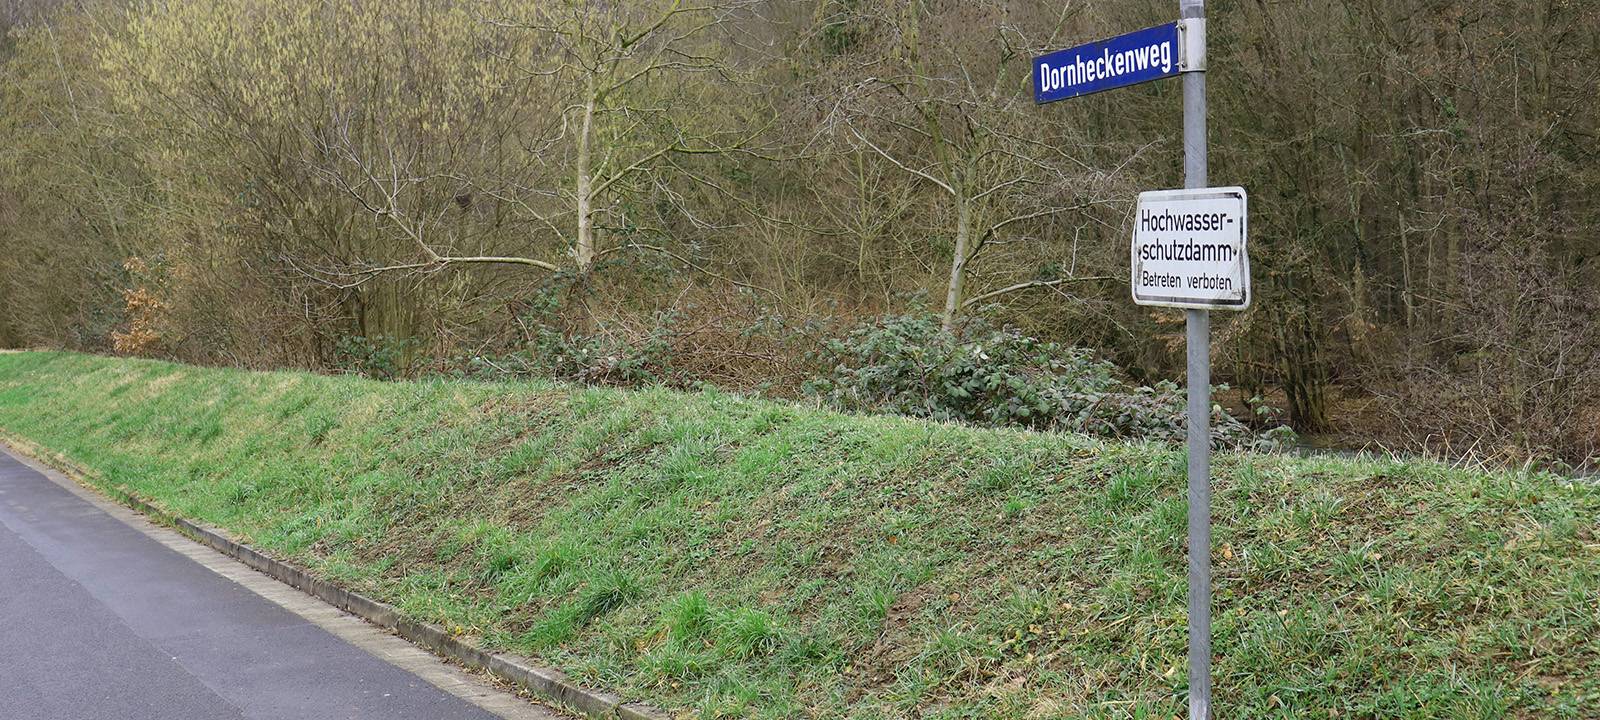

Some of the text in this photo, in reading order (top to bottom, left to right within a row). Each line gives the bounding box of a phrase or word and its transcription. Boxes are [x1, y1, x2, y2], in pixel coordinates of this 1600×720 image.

[1040, 40, 1171, 92] Dornheckenweg
[1141, 209, 1233, 232] Hochwasser-
[1142, 238, 1232, 262] schutzdamm
[1142, 271, 1232, 290] Betreten verboten
